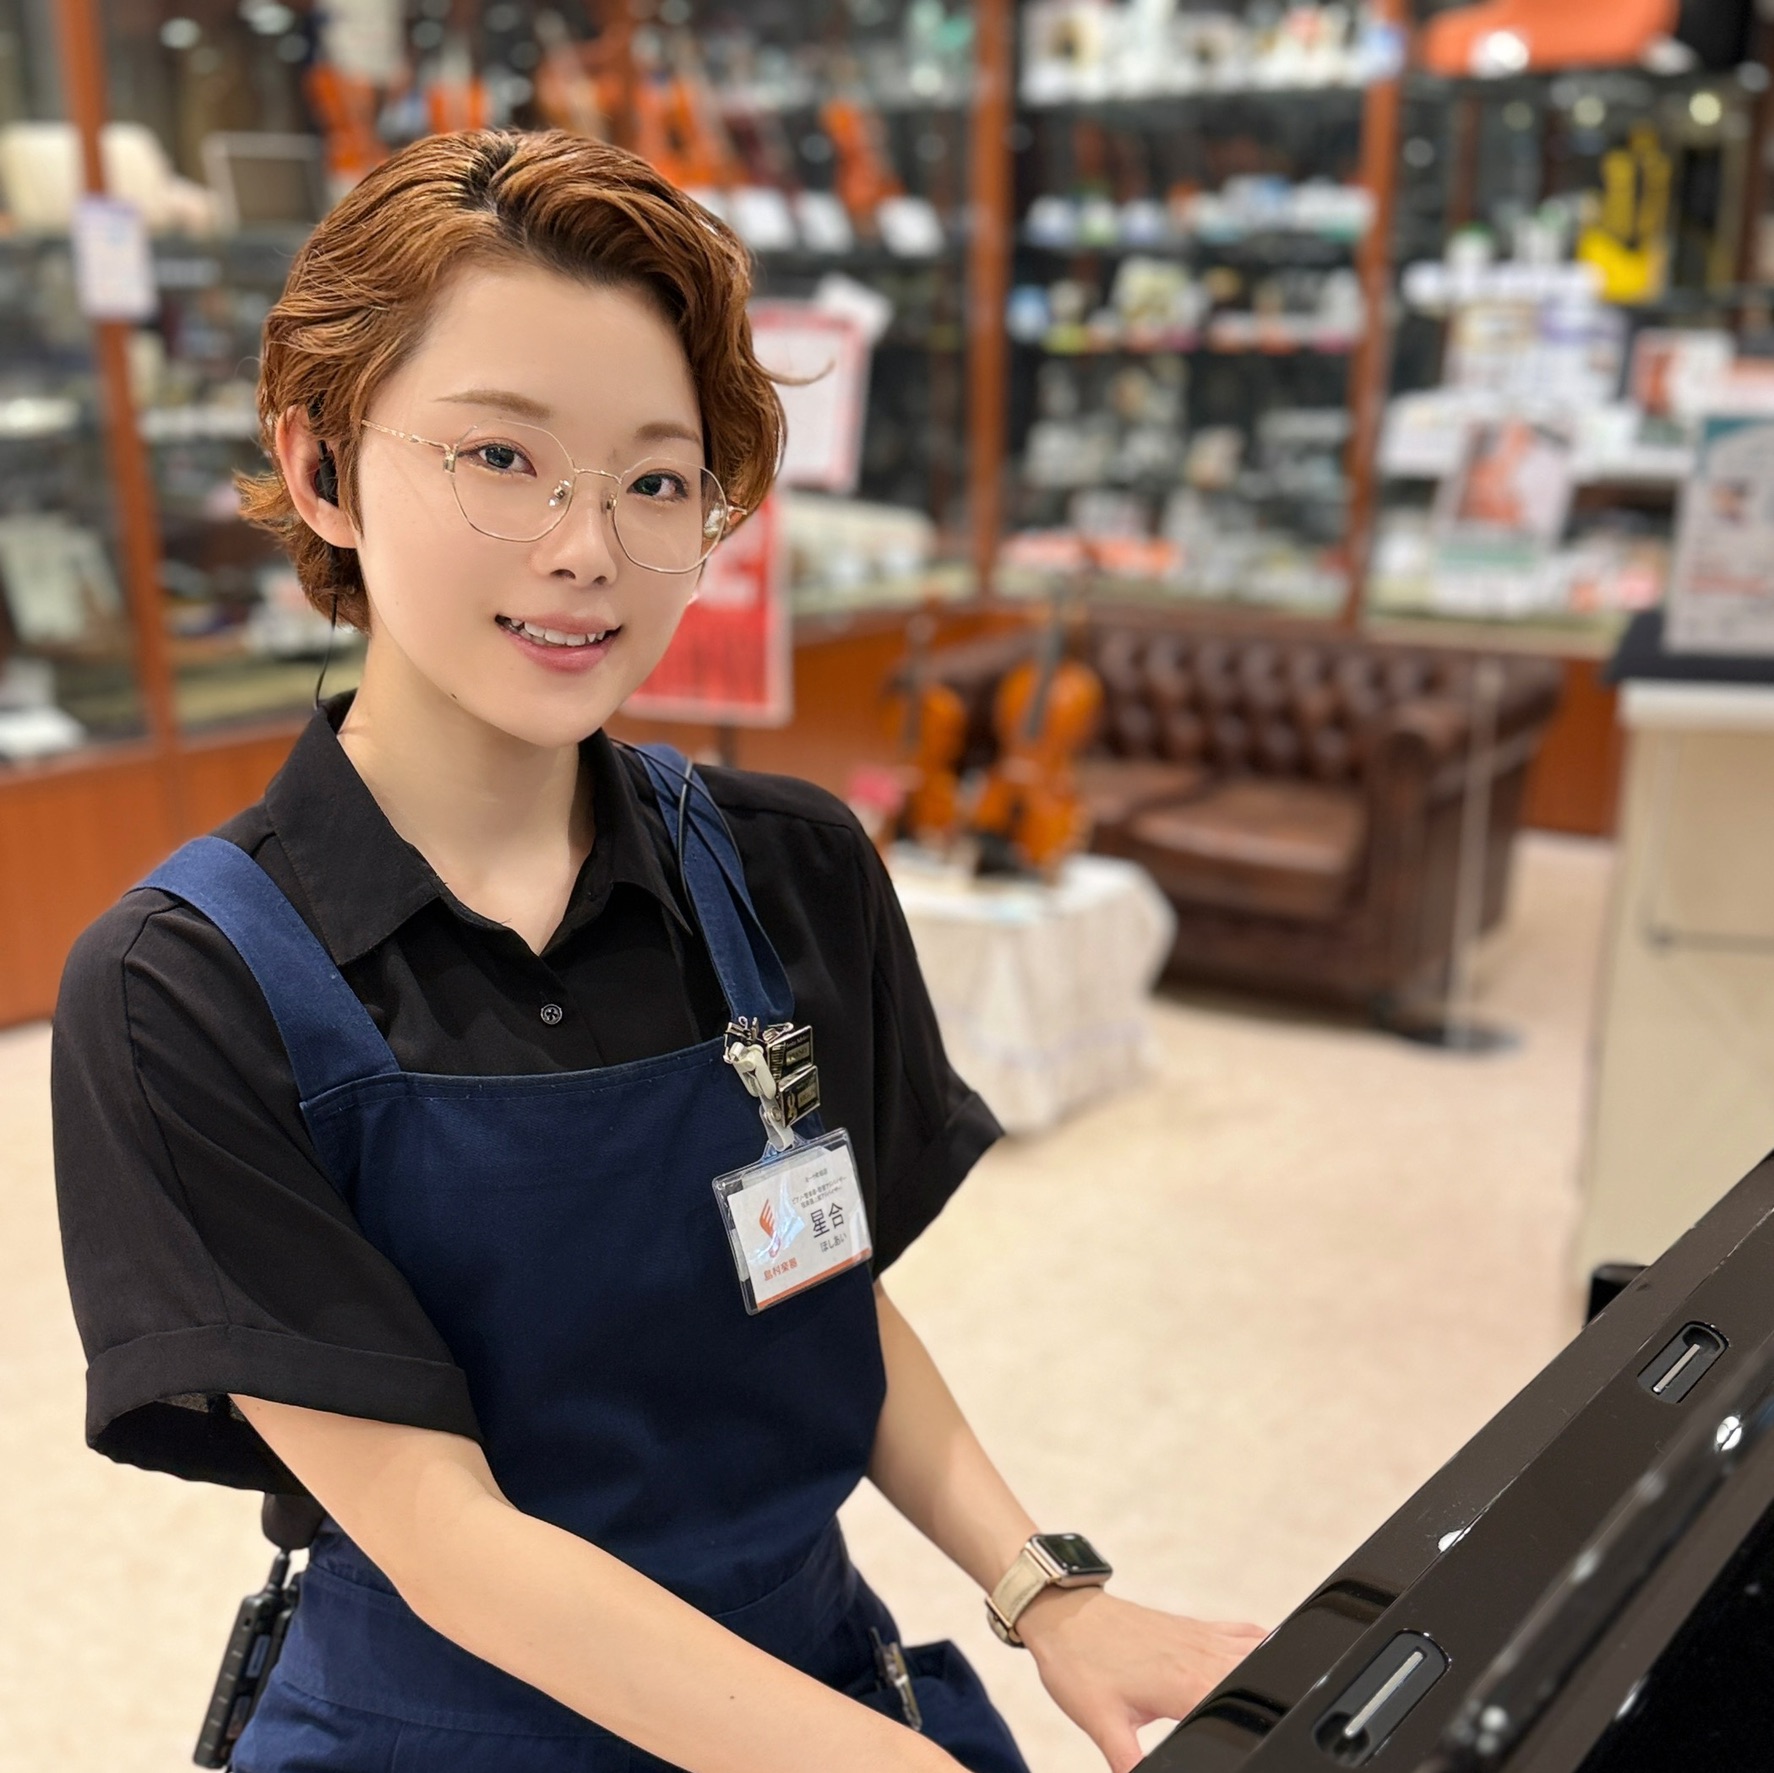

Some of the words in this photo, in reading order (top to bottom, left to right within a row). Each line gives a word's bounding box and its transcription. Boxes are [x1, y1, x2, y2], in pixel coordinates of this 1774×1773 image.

[810, 1202, 844, 1239] 星合
[820, 1232, 847, 1252] ほしあい
